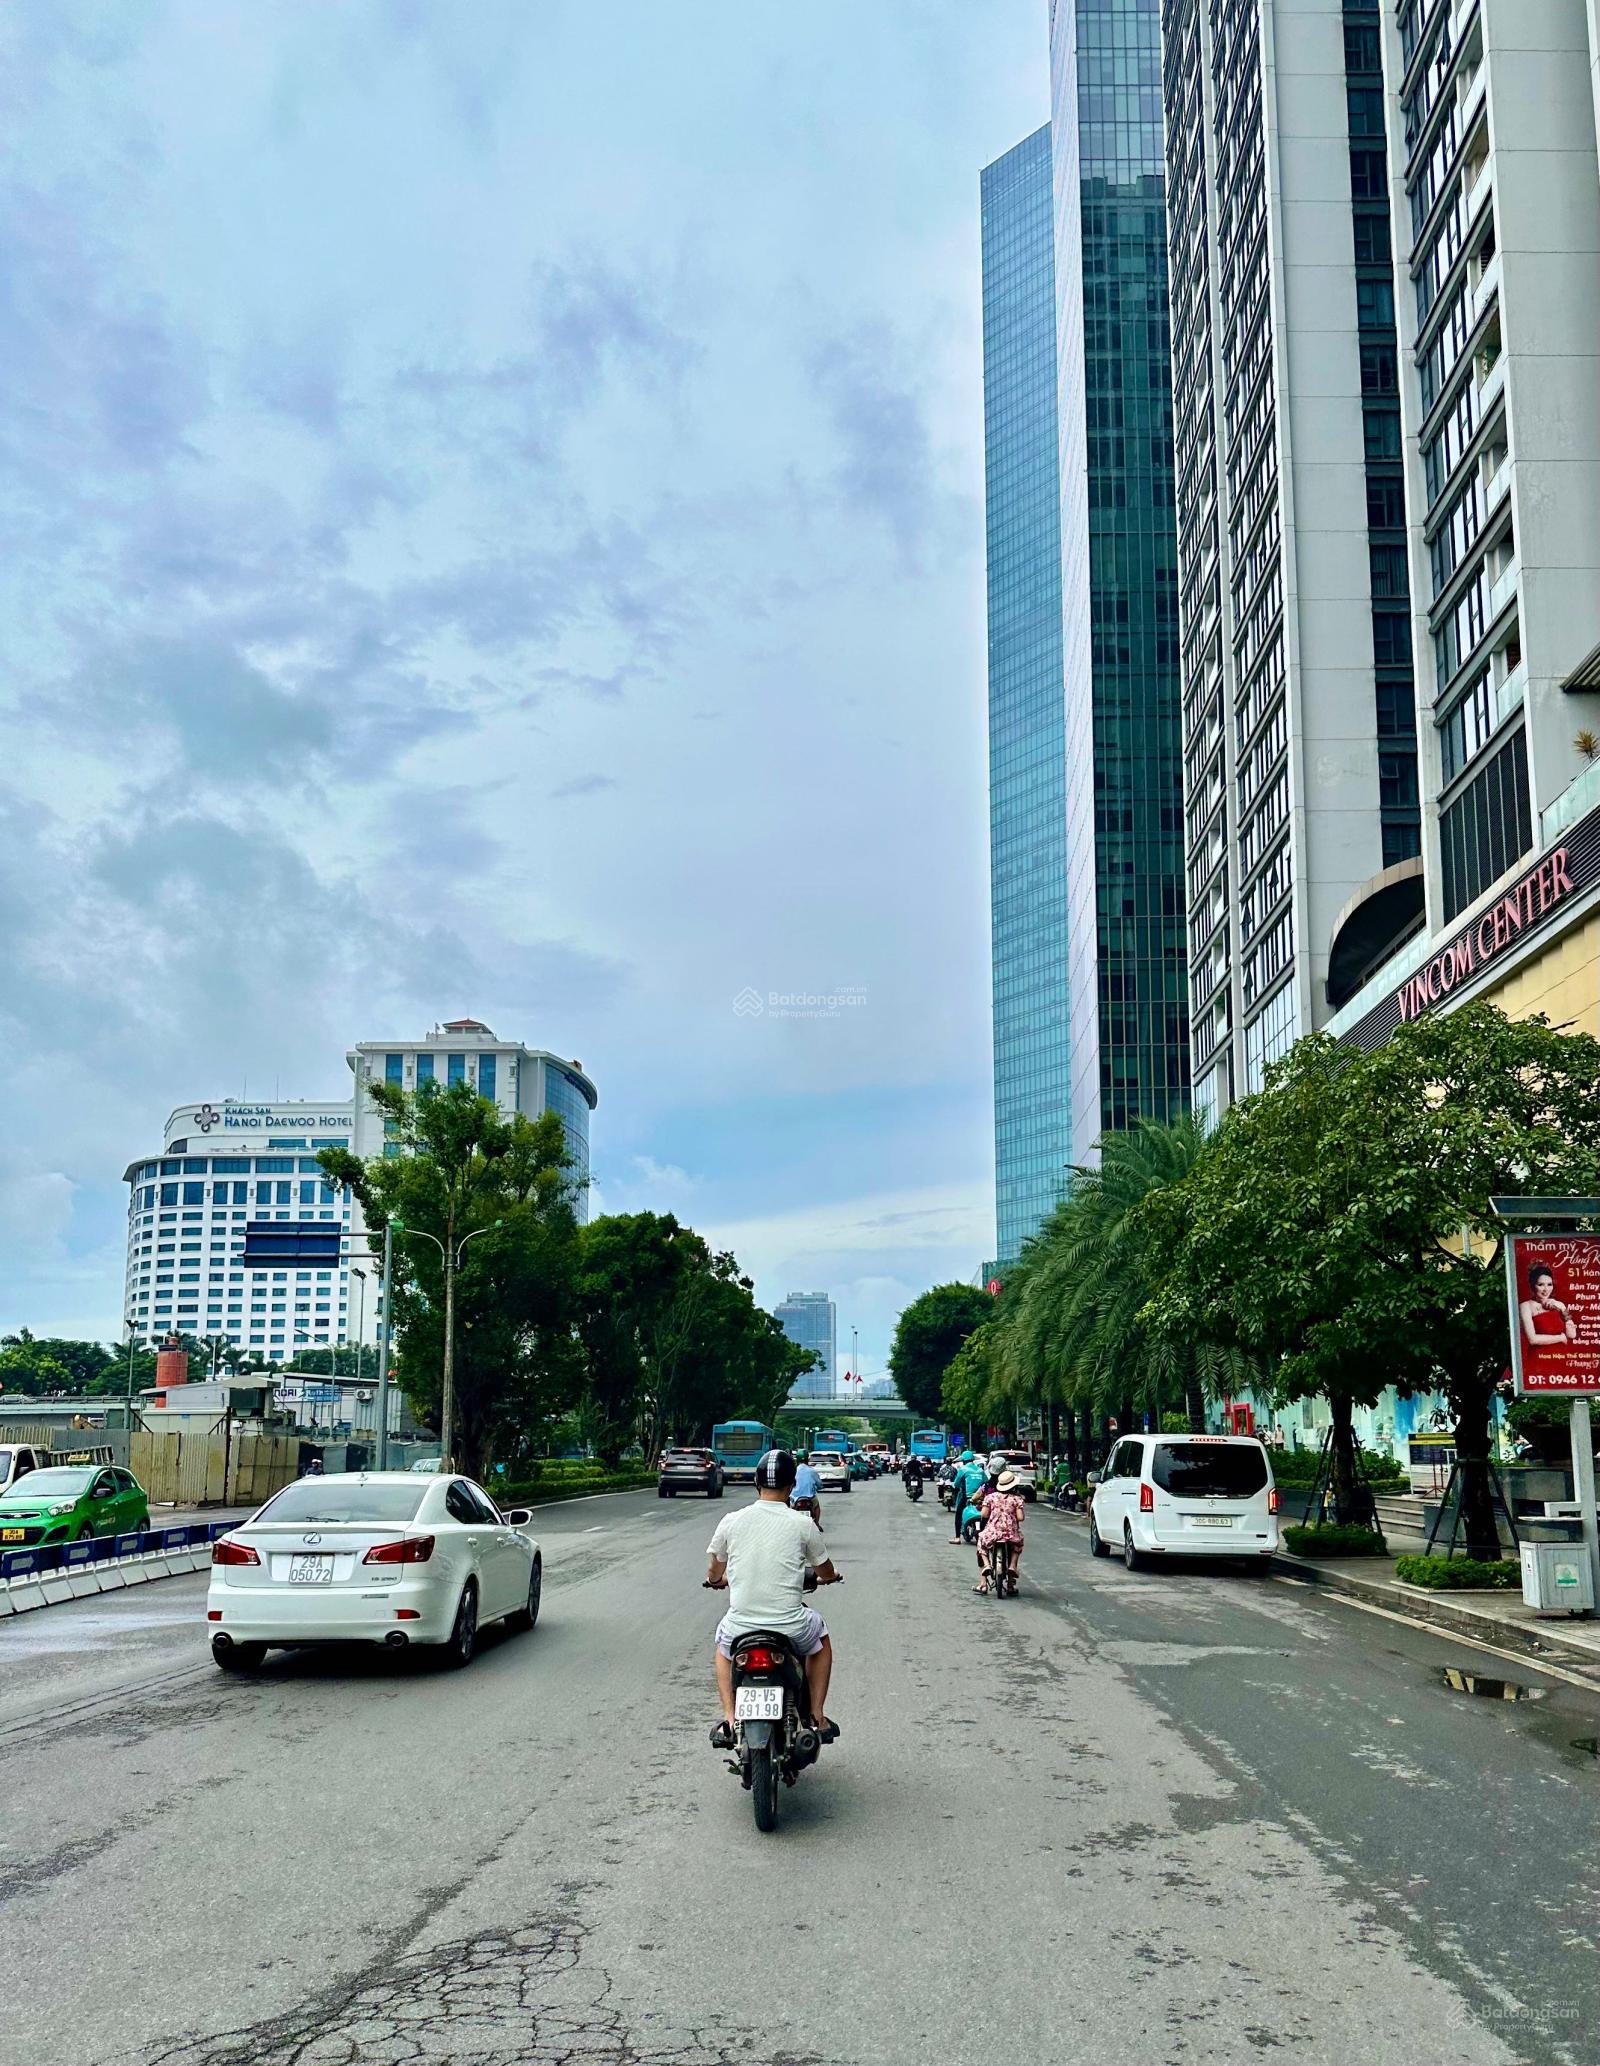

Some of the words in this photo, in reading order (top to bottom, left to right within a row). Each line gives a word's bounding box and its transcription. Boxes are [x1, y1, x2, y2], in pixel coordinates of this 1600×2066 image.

[1398, 931, 1477, 1023] VINCOM
[1477, 847, 1575, 960] CENTER
[225, 1116, 261, 1127] HANOI
[266, 1116, 315, 1127] DAEWOO
[319, 1117, 353, 1127] HOTEL
[1568, 1267, 1580, 1277] 51
[1529, 1375, 1546, 1384] ĐT:
[1549, 1375, 1577, 1384] 0946
[1581, 1375, 1595, 1384] 12
[301, 1555, 323, 1568] 29A
[290, 1569, 331, 1581] 050.72
[743, 1689, 776, 1702] 29-V5
[738, 1703, 779, 1717] 691.98
